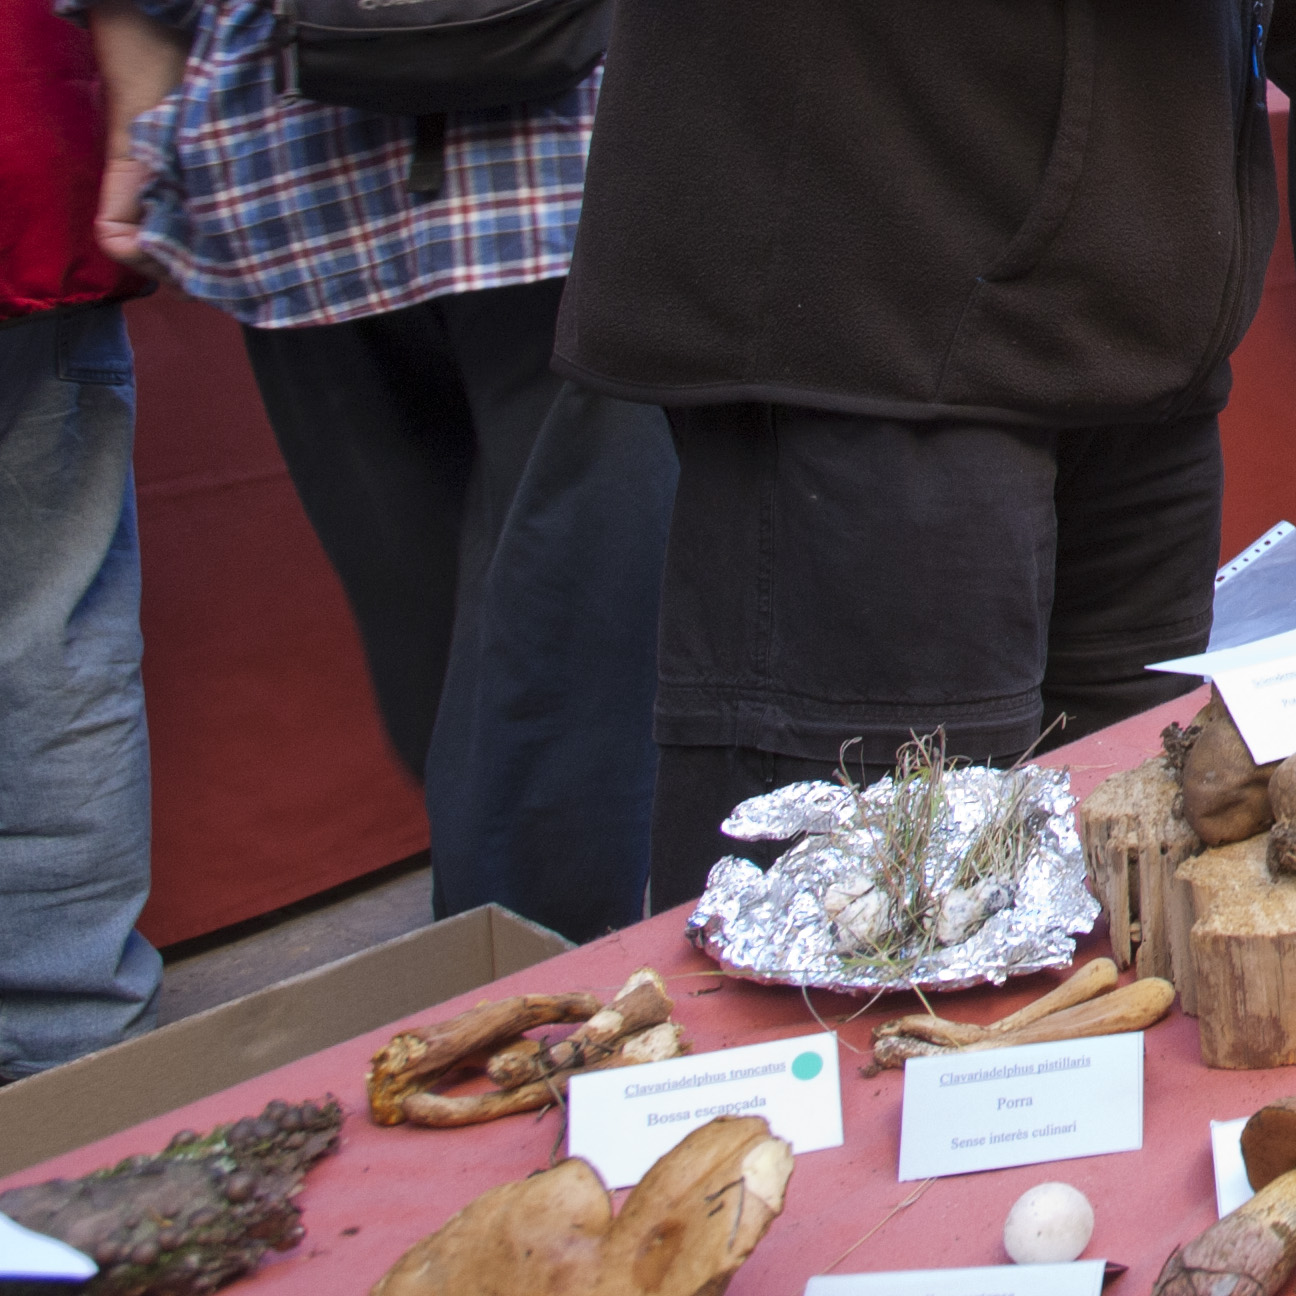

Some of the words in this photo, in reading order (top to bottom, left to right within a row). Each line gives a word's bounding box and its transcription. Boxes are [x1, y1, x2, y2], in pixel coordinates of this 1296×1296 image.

[624, 1071, 727, 1098] Clavariadelphus
[729, 1060, 786, 1082] truncatus
[939, 1063, 1035, 1088] Clavariadelphus
[1037, 1055, 1091, 1075] pistillaris
[646, 1109, 691, 1127] Bossa
[996, 1095, 1034, 1111] Porra
[950, 1137, 986, 1151] Sense
[989, 1128, 1029, 1146] interès
[1031, 1120, 1078, 1138] culinari
